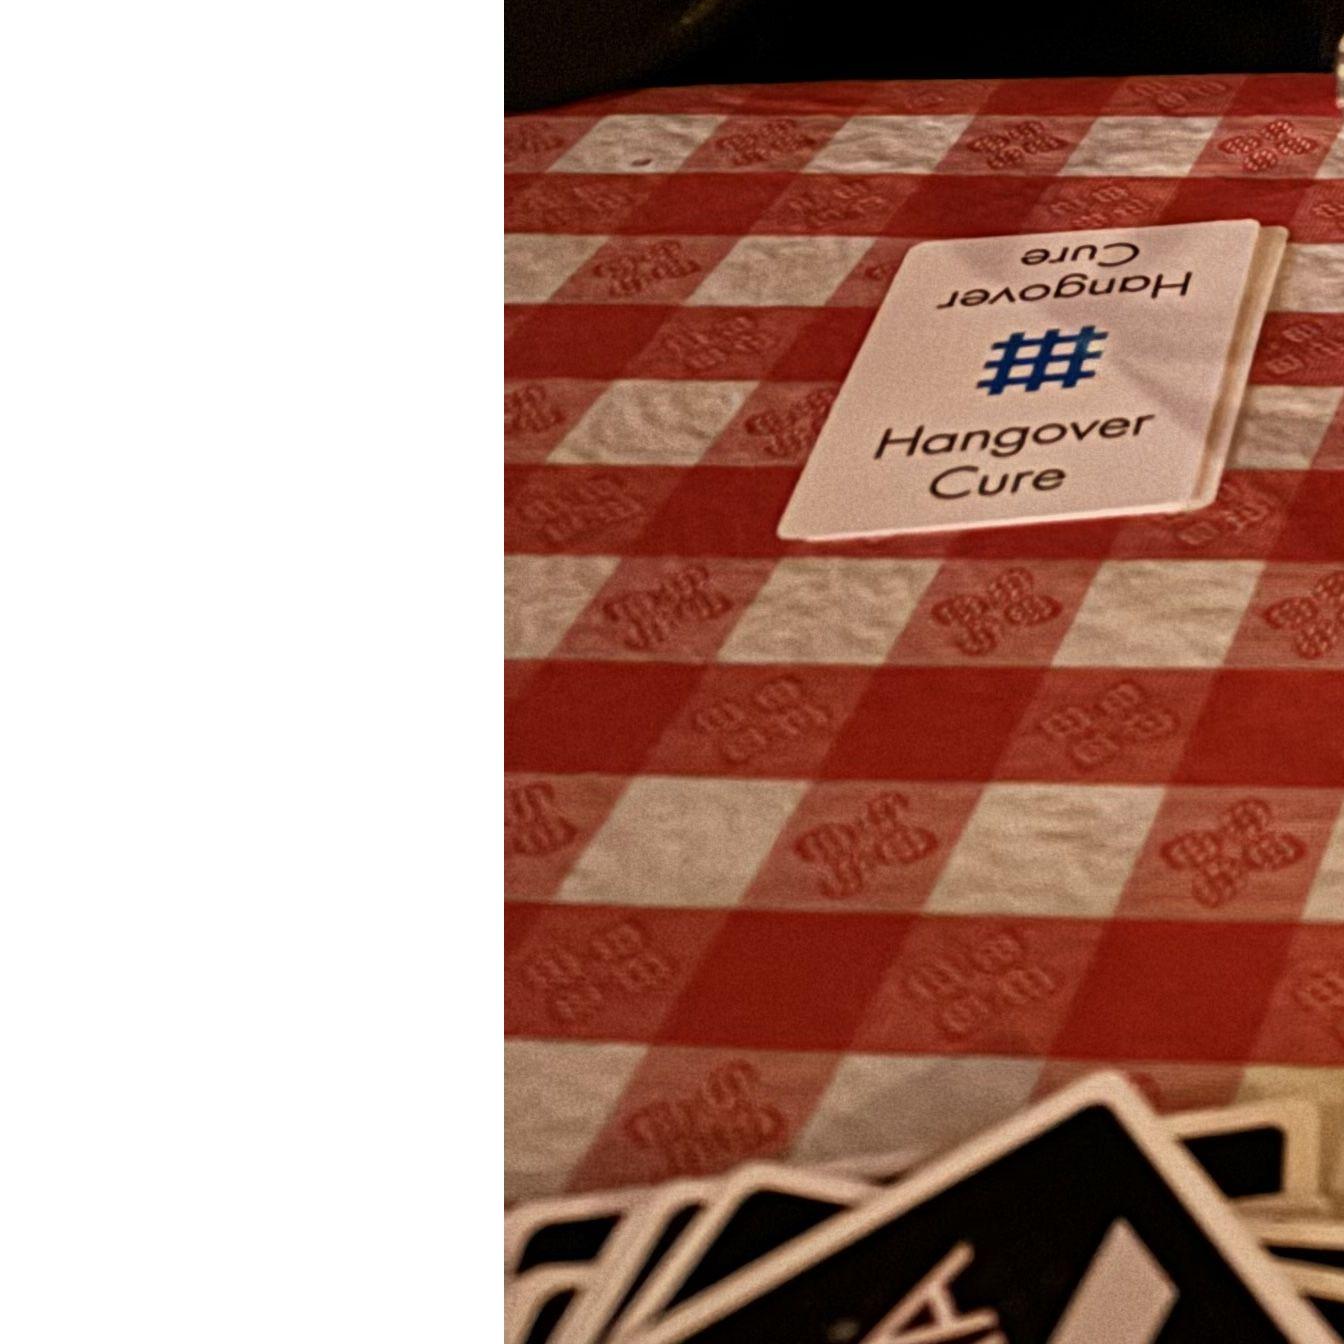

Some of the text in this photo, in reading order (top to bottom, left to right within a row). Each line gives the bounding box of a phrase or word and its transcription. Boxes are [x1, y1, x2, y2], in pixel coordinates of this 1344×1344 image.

[1020, 241, 1141, 267] Cure
[935, 271, 1194, 310] Hangover
[873, 414, 1157, 461] Hangover
[928, 465, 1068, 500] Cure
